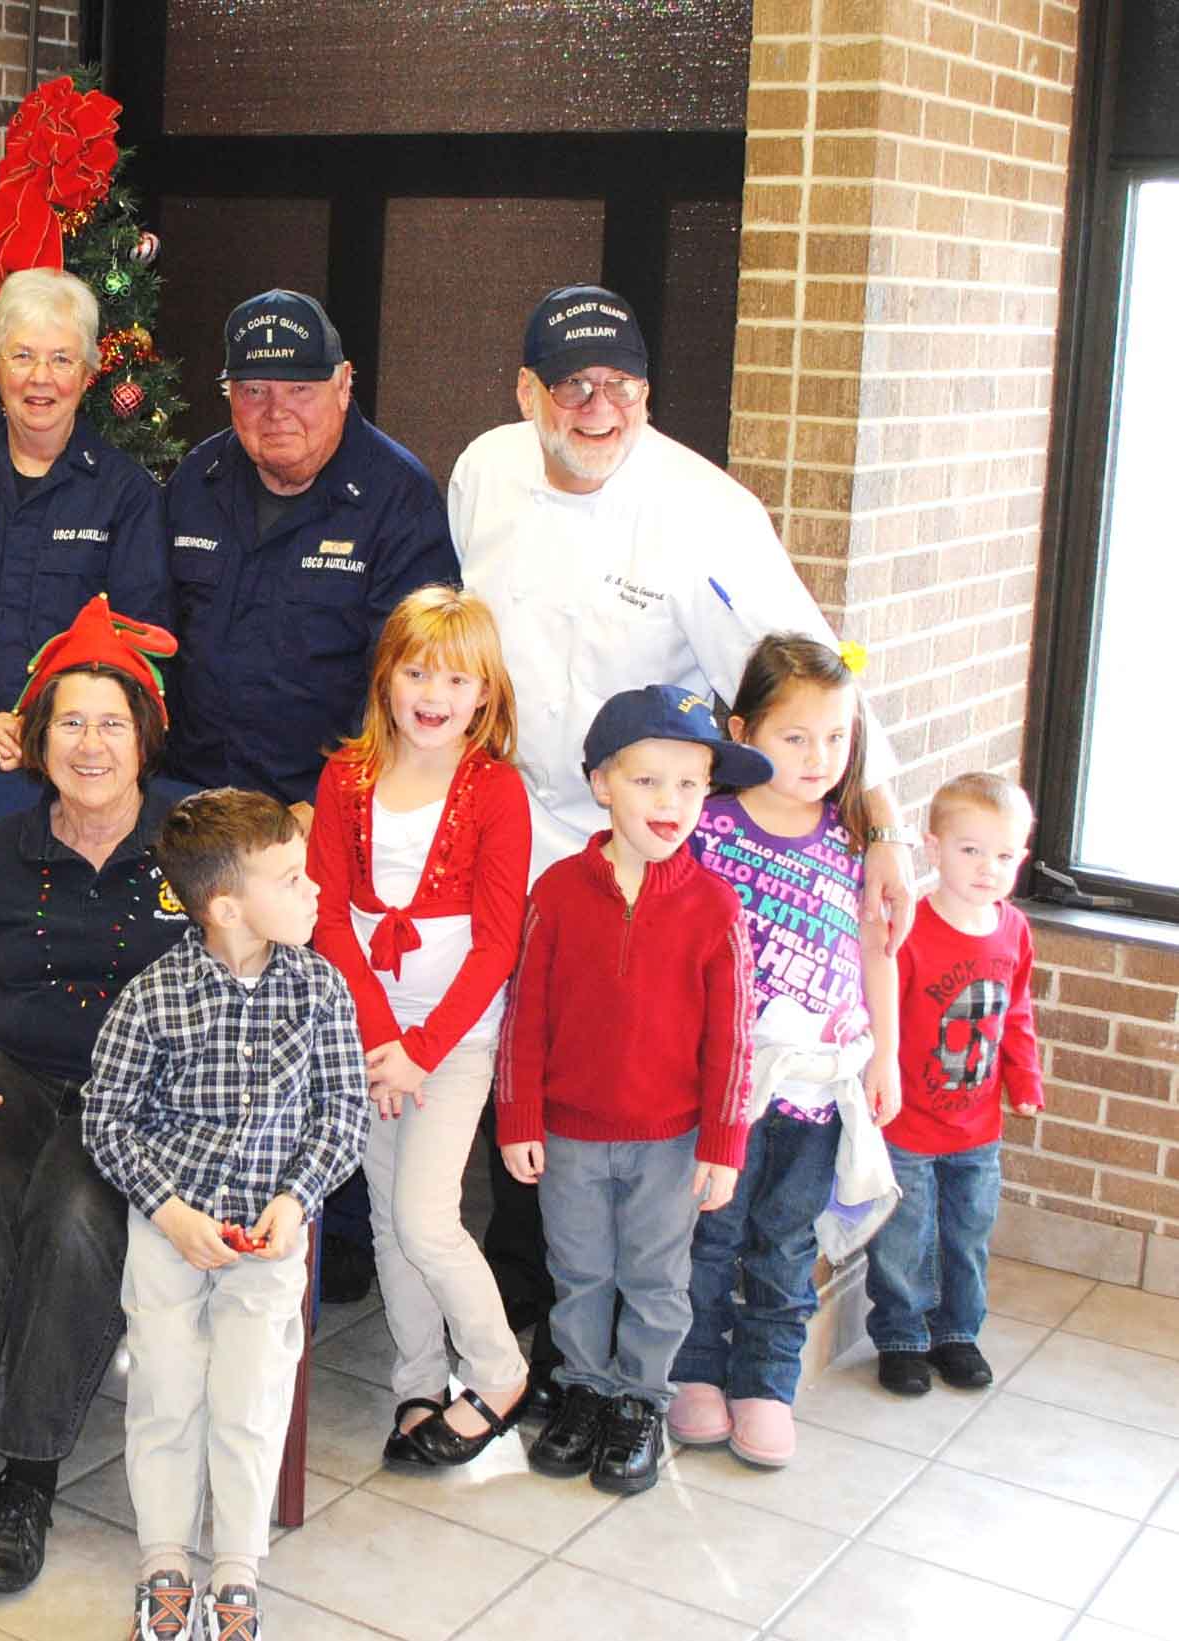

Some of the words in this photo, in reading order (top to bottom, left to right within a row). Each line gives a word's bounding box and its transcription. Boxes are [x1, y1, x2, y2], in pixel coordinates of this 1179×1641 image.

[247, 314, 278, 330] COAST
[279, 317, 310, 340] GUARD
[566, 302, 598, 318] COAST
[599, 303, 629, 323] GUARD
[565, 326, 618, 341] AUXILIARY
[245, 347, 295, 361] AUXILIARY
[52, 529, 76, 542] USCG
[301, 556, 324, 570] USCG
[324, 557, 367, 574] AUXILIARY
[717, 842, 764, 869] HELLO
[764, 862, 811, 890] KITTY
[735, 836, 774, 859] HELLO
[773, 853, 811, 878] KITTY
[754, 872, 822, 917] KITTY
[757, 893, 839, 950] KITTY
[769, 923, 830, 966] HELLO
[766, 974, 808, 1003] HELLO
[925, 959, 977, 1004] ROCK
